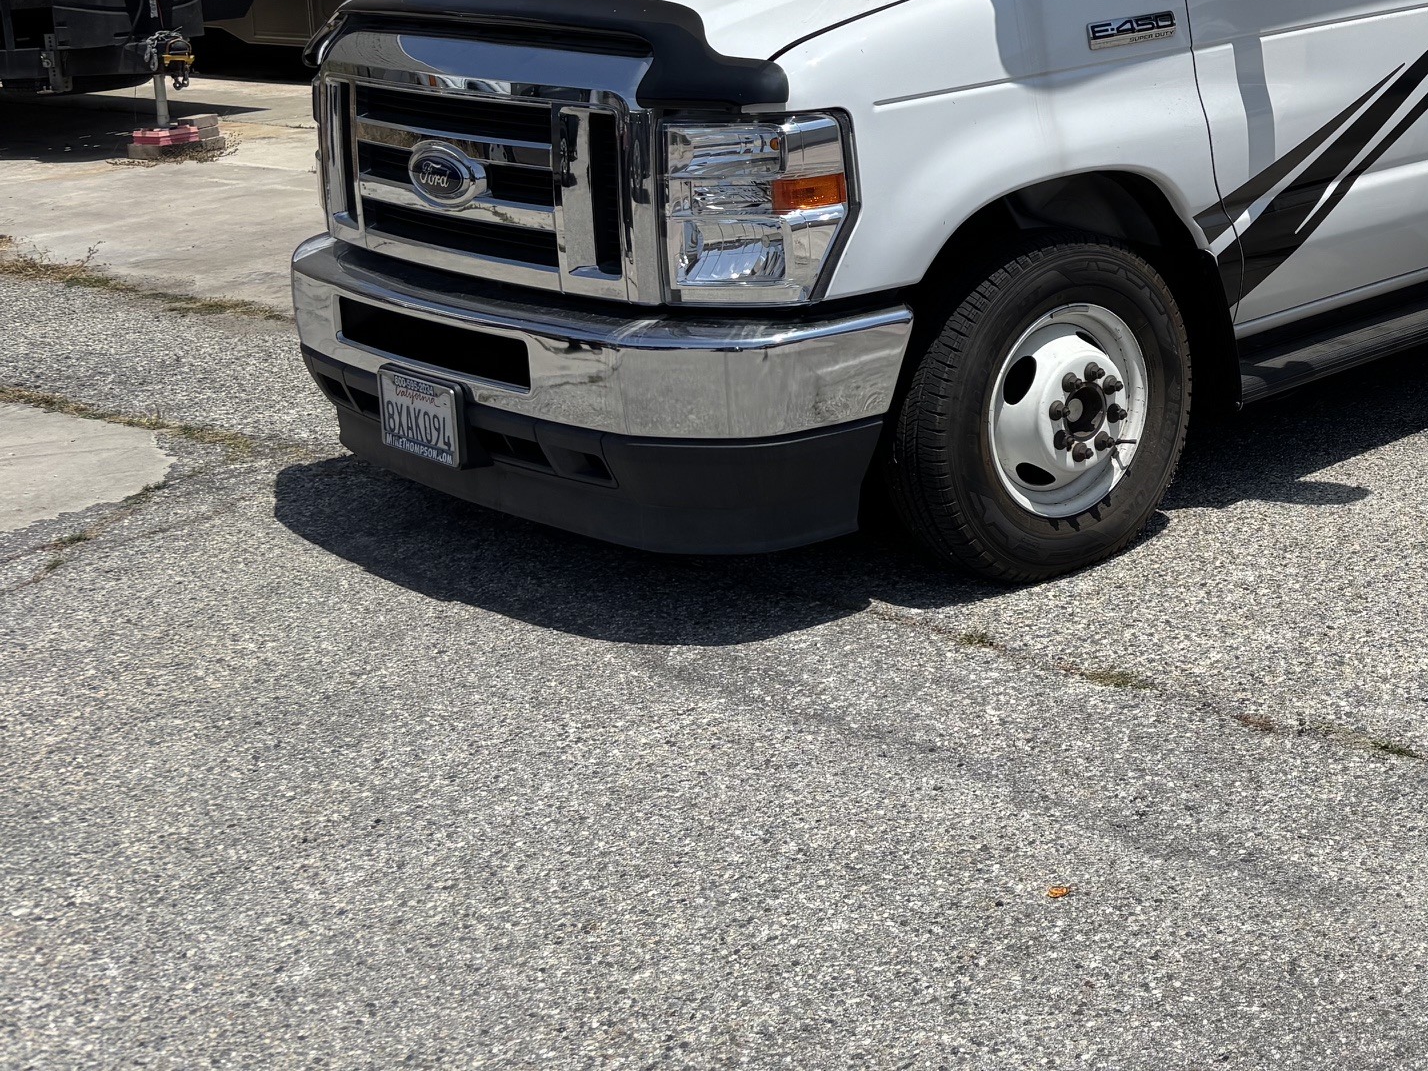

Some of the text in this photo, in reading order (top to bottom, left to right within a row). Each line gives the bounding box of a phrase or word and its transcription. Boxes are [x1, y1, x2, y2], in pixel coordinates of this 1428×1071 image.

[1091, 13, 1176, 40] E-450
[1129, 30, 1175, 43] SUPER DUTY
[420, 160, 452, 188] Ford
[395, 386, 441, 407] California
[386, 400, 452, 450] 8XAK094
